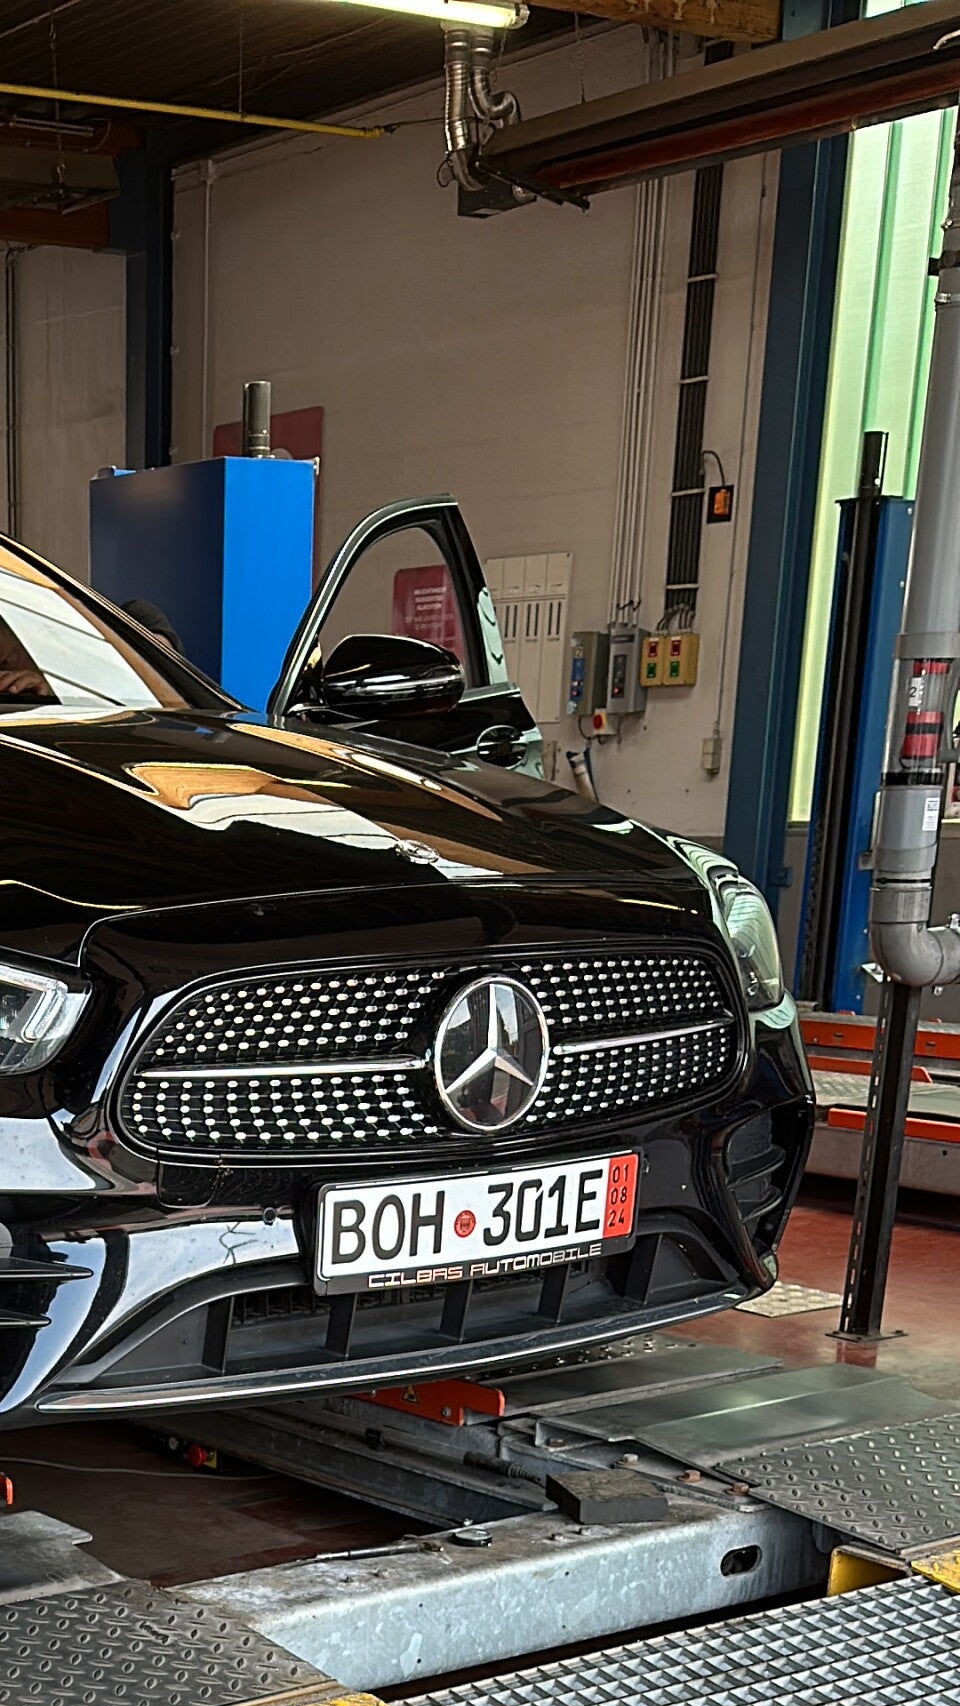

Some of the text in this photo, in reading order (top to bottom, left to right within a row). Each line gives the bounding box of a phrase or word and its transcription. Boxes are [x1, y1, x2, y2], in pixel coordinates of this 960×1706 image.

[612, 1164, 629, 1183] 01
[610, 1186, 628, 1205] 08
[331, 1168, 604, 1265] BOH 301E
[608, 1208, 625, 1227] 24
[368, 1243, 602, 1288] CILBAS AUTOMOBILE
